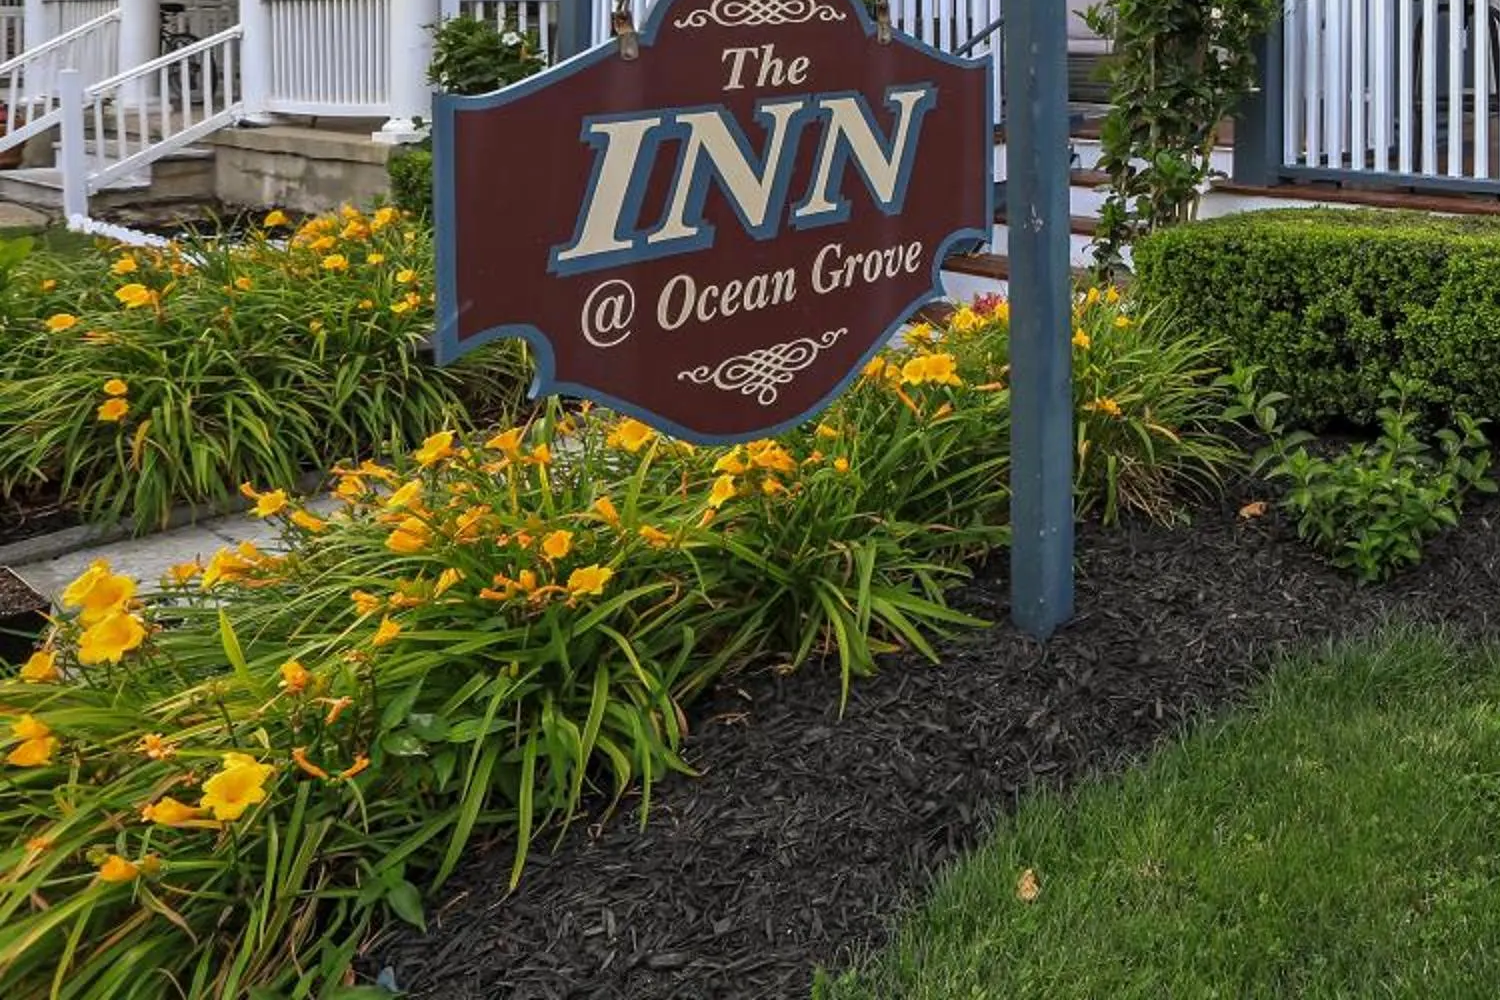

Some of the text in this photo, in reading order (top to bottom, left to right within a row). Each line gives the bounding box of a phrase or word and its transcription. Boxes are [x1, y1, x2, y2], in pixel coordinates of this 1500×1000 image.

[722, 44, 809, 90] The
[557, 89, 927, 262] INN
[581, 240, 924, 348] @ Ocean Grove
